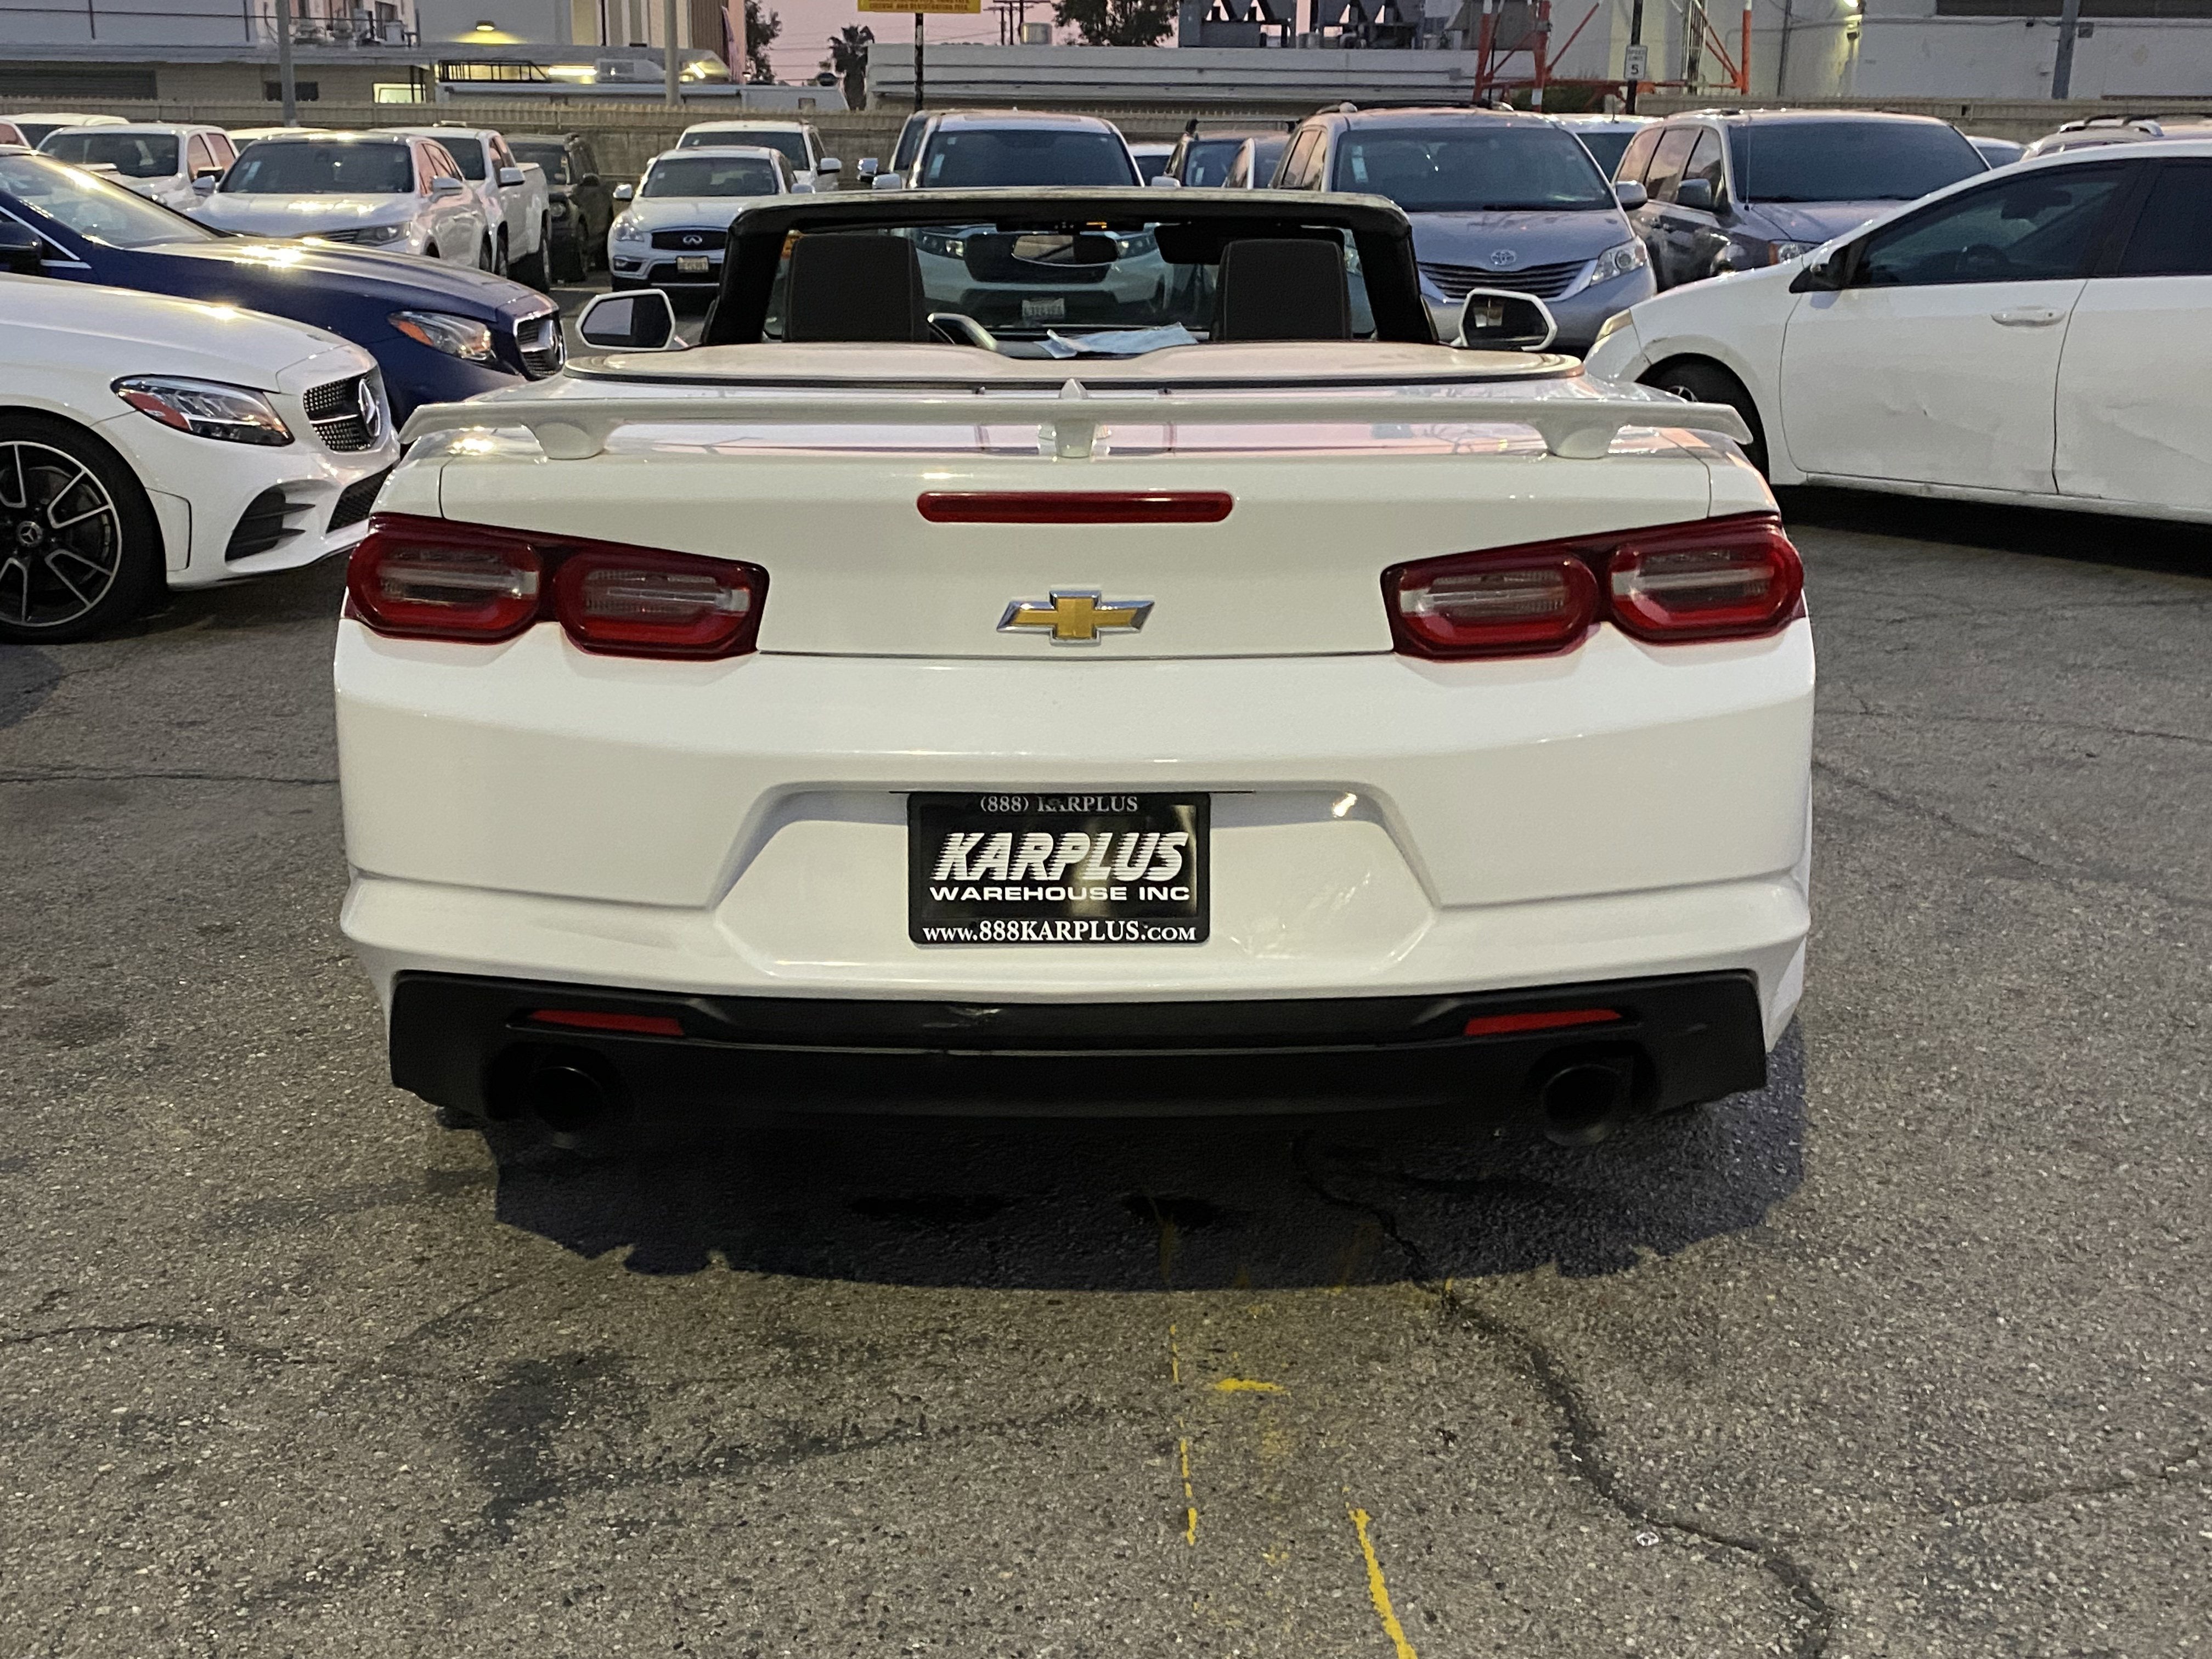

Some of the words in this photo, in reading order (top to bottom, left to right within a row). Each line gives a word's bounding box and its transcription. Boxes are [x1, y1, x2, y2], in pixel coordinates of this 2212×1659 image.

[1631, 64, 1639, 75] 5
[980, 796, 1029, 812] (888)
[930, 832, 1189, 881] KARPLUS
[929, 887, 1127, 901] WAREHOUSE
[1139, 887, 1189, 901] INC
